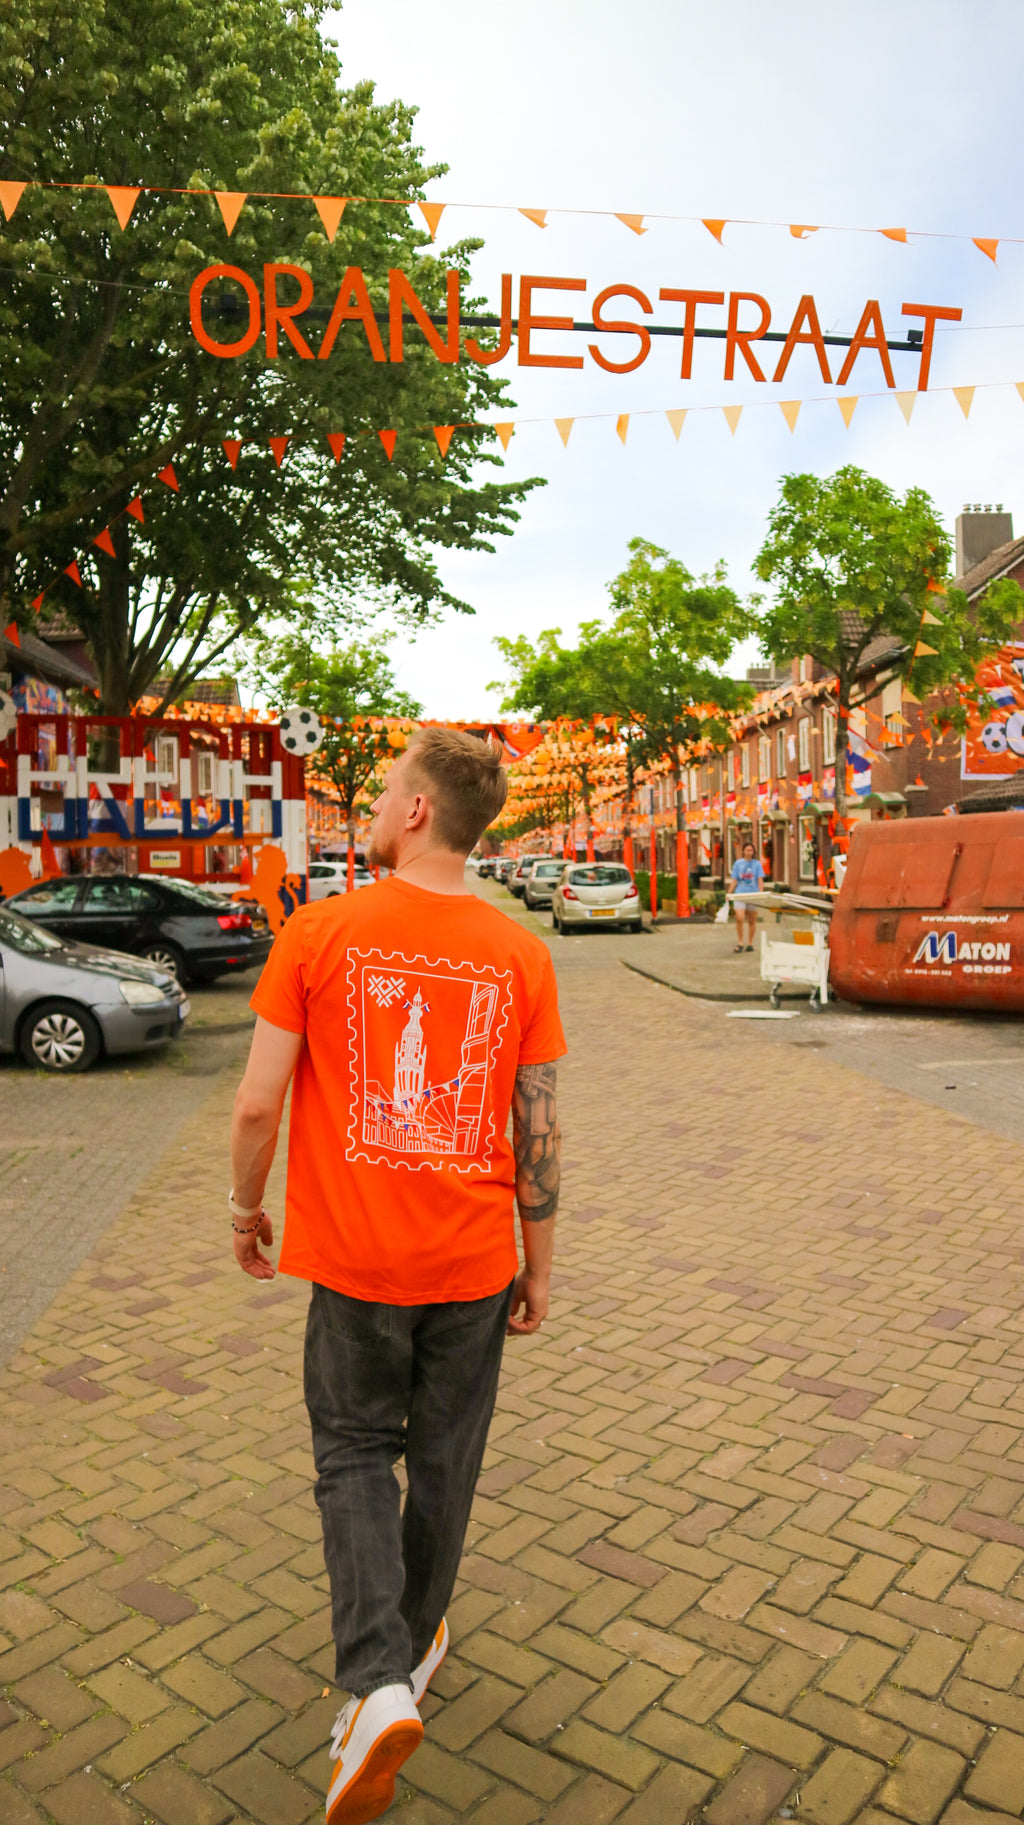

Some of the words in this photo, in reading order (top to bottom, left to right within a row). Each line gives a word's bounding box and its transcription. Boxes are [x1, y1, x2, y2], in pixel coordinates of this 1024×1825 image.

[188, 264, 963, 392] ORANJESTRAAT
[17, 713, 283, 840] BREDA
[921, 914, 1010, 925] www.matongroep.nl
[912, 931, 1011, 964] MATON
[962, 965, 1012, 974] GROEP
